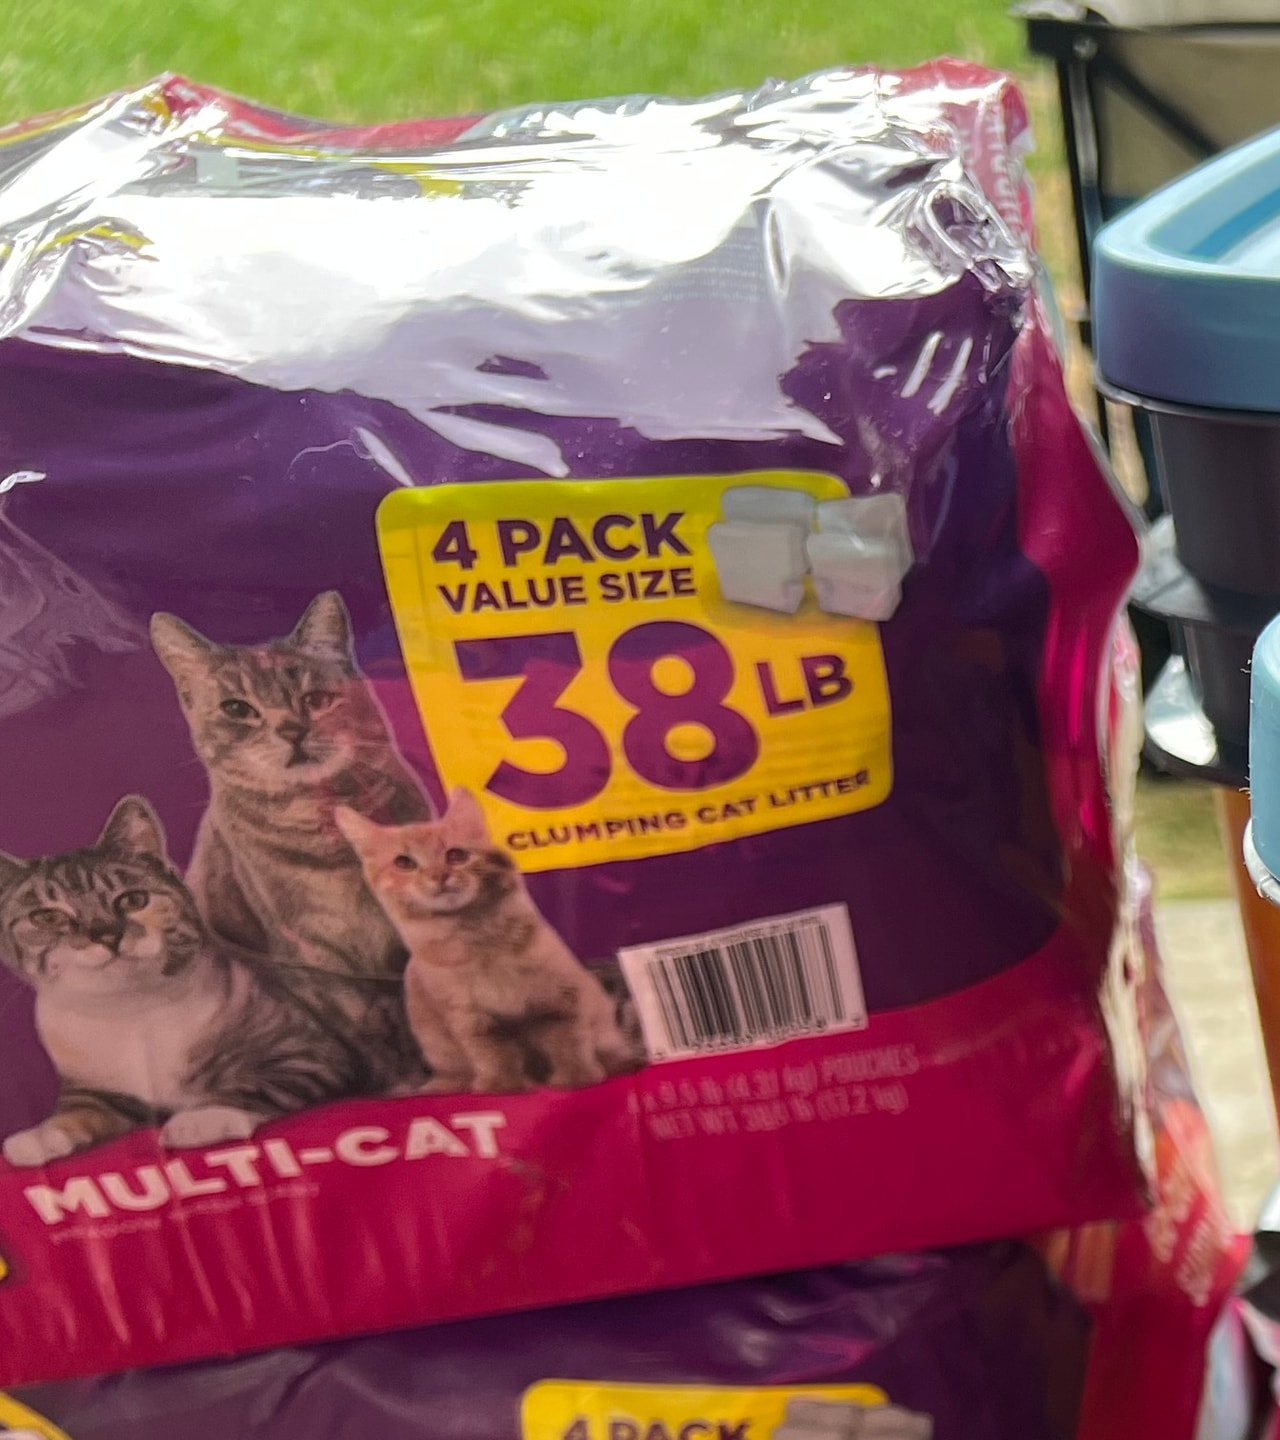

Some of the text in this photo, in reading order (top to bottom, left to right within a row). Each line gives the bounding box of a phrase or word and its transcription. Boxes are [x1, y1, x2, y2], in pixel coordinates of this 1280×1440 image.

[432, 512, 692, 570] 4 PACK
[438, 567, 697, 614] VALUE SIZE
[453, 620, 853, 810] 38 LB
[506, 770, 870, 851] CLUMPING CAT LITTER
[24, 1111, 506, 1225] MULTI-CAT
